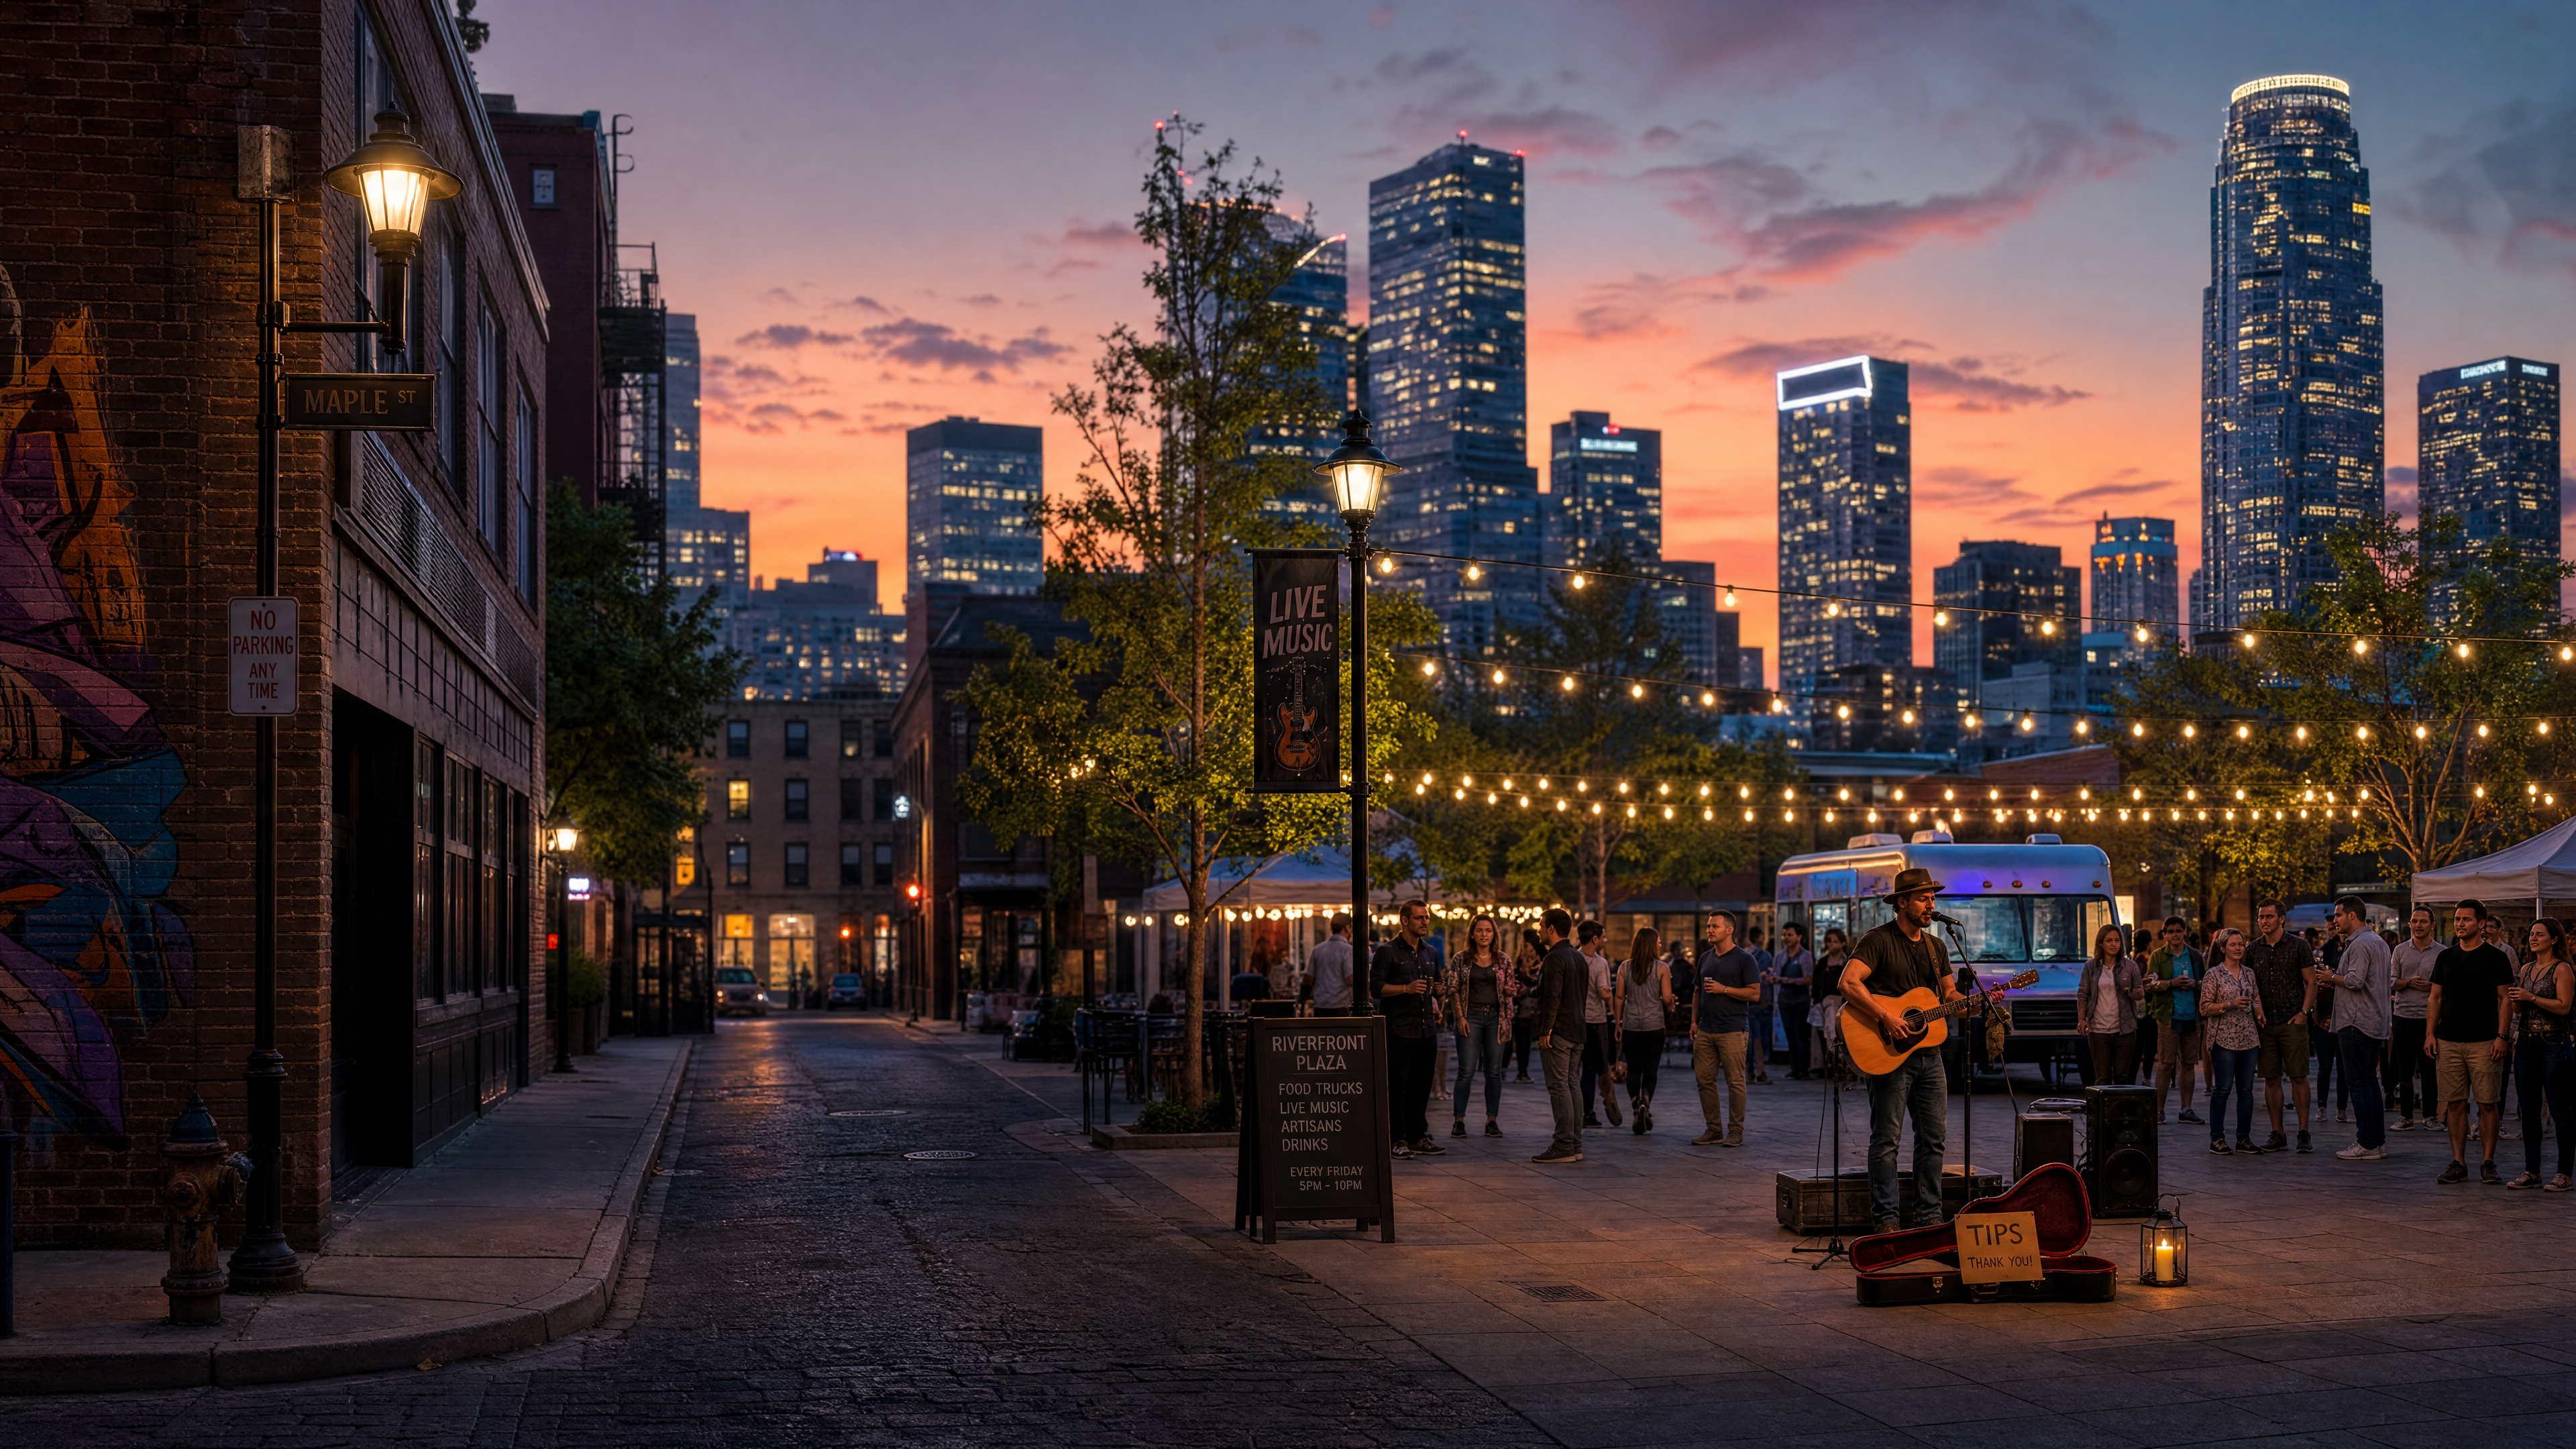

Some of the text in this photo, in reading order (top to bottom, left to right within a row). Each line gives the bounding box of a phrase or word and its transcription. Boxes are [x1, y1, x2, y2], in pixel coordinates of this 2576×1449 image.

[305, 389, 416, 415] MAPLE ST
[1269, 584, 1327, 625] LIVE
[250, 610, 276, 631] NO
[233, 635, 294, 655] PARKING
[1262, 623, 1334, 659] MUSIC
[249, 662, 277, 678] ANY
[247, 682, 279, 699] TIME
[1272, 1034, 1366, 1052] RIVERFRONT
[1296, 1055, 1347, 1071] PLAZA
[1279, 1081, 1363, 1095] FOOD TRUCKS
[1280, 1101, 1349, 1114] LIVE MUSIC
[1281, 1119, 1342, 1133] ARTISANS
[1282, 1138, 1328, 1151] DRINKS
[1290, 1165, 1363, 1177] EVERY FRIDAY
[1299, 1181, 1322, 1191] 5PM
[1334, 1180, 1362, 1191] 10PM
[1966, 1223, 2023, 1246] TIPS
[1967, 1254, 2033, 1269] THANK YOU!
